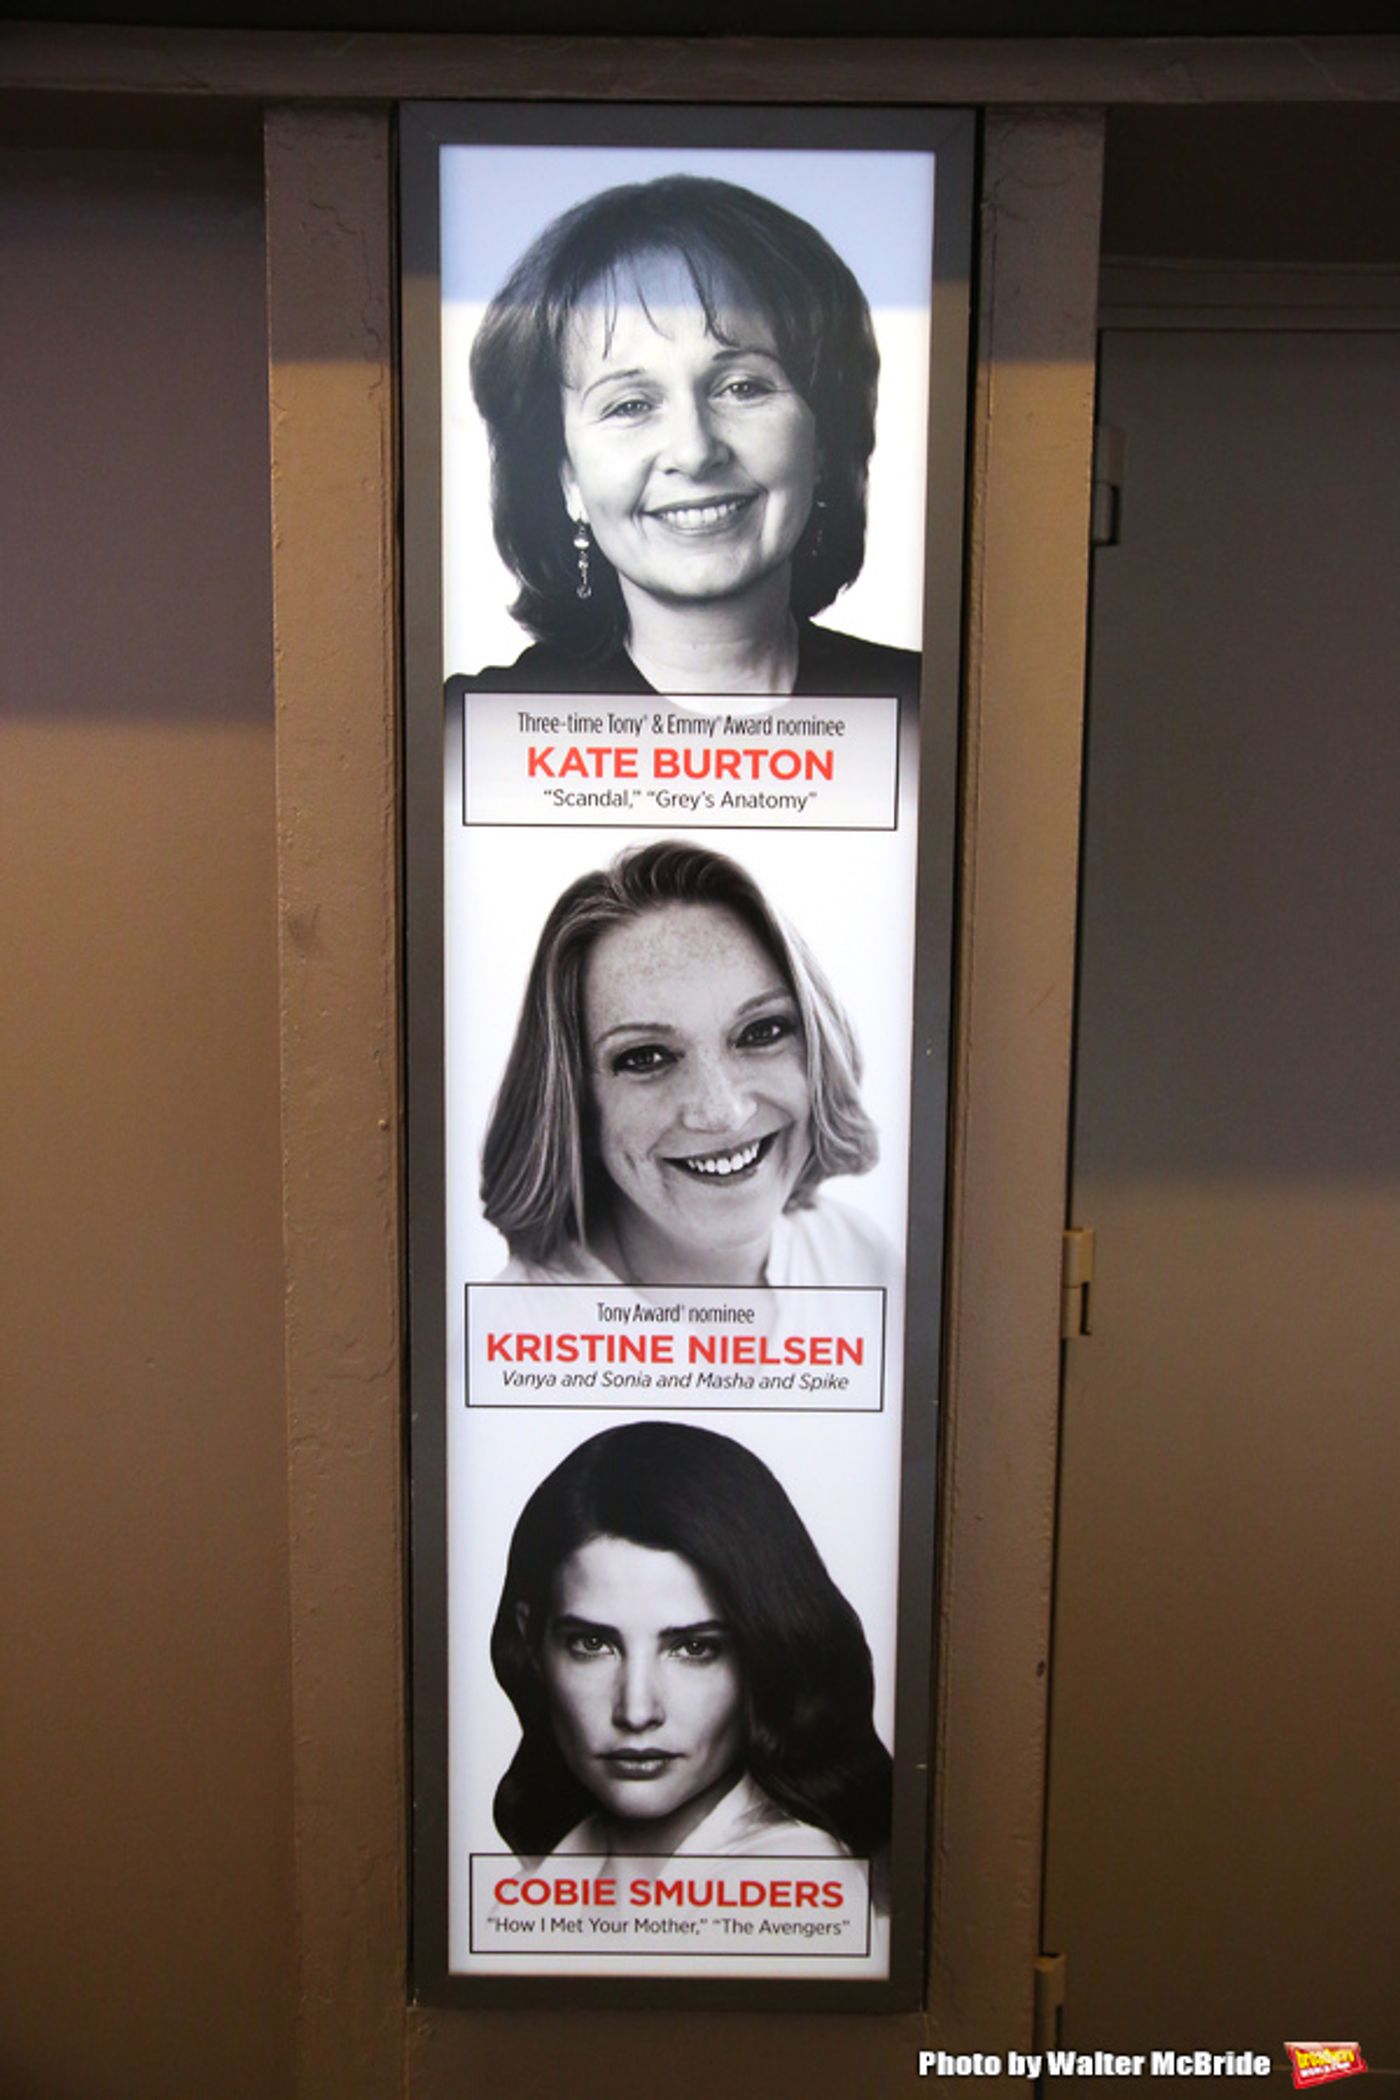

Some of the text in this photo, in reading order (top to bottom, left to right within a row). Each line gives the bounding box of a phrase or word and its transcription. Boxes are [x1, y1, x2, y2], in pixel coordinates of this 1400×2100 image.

[518, 712, 603, 734] Three-time
[652, 714, 663, 734] &
[723, 715, 772, 736] Award
[777, 716, 845, 737] nominee
[528, 747, 834, 780] KATE BURTON
[597, 1302, 631, 1325] Tony
[688, 1304, 755, 1324] nominee
[487, 1333, 864, 1366] KRISTINE NIELSEN
[502, 1370, 849, 1392] Vanya and Sonia and Masha and Spike
[494, 1878, 844, 1908] COBIE SMULDERS
[541, 1917, 545, 1932] I
[551, 1918, 583, 1933] Met
[588, 1918, 628, 1934] Your
